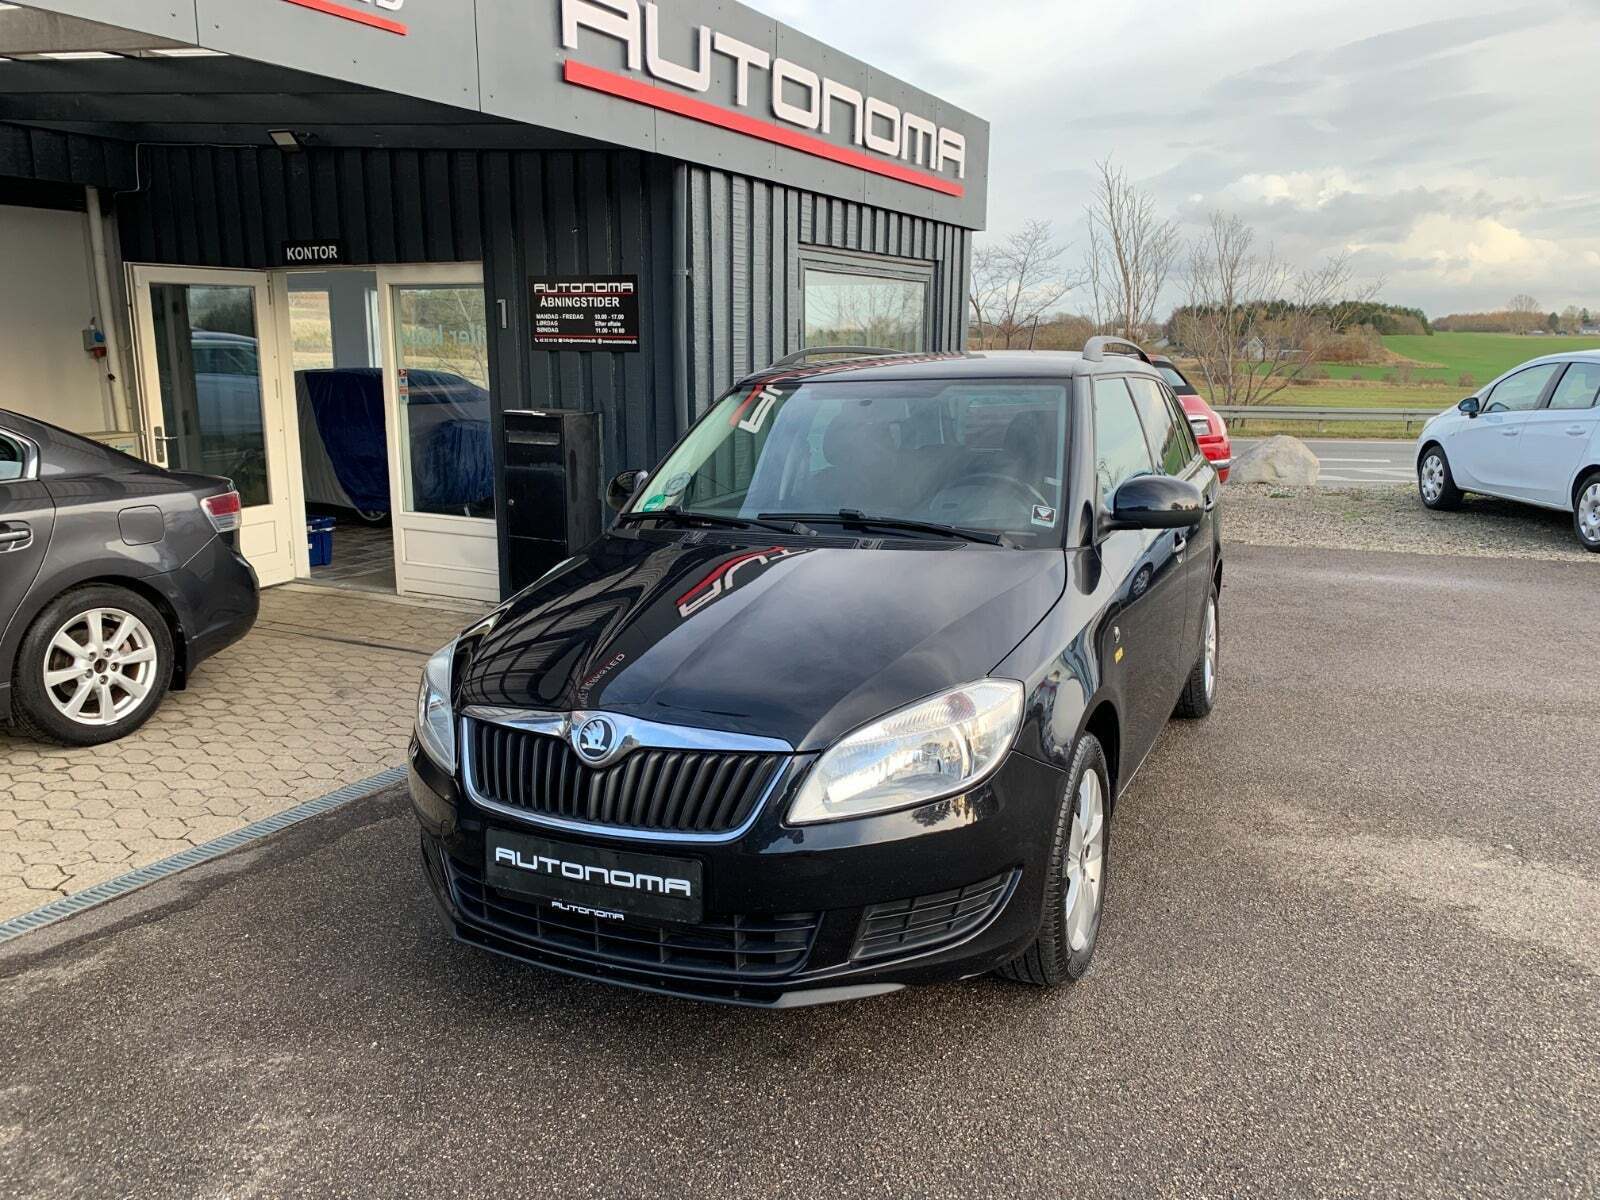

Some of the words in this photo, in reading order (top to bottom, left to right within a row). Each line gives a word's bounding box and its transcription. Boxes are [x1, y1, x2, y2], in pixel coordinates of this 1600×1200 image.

[562, 0, 965, 179] AUTONOMA
[286, 245, 338, 260] KONTOR
[534, 283, 634, 293] AUTONOMA
[540, 295, 620, 307] ÅBNINGSTIDER
[495, 847, 691, 897] AUTONOMA
[551, 901, 625, 921] AUTONOMA
